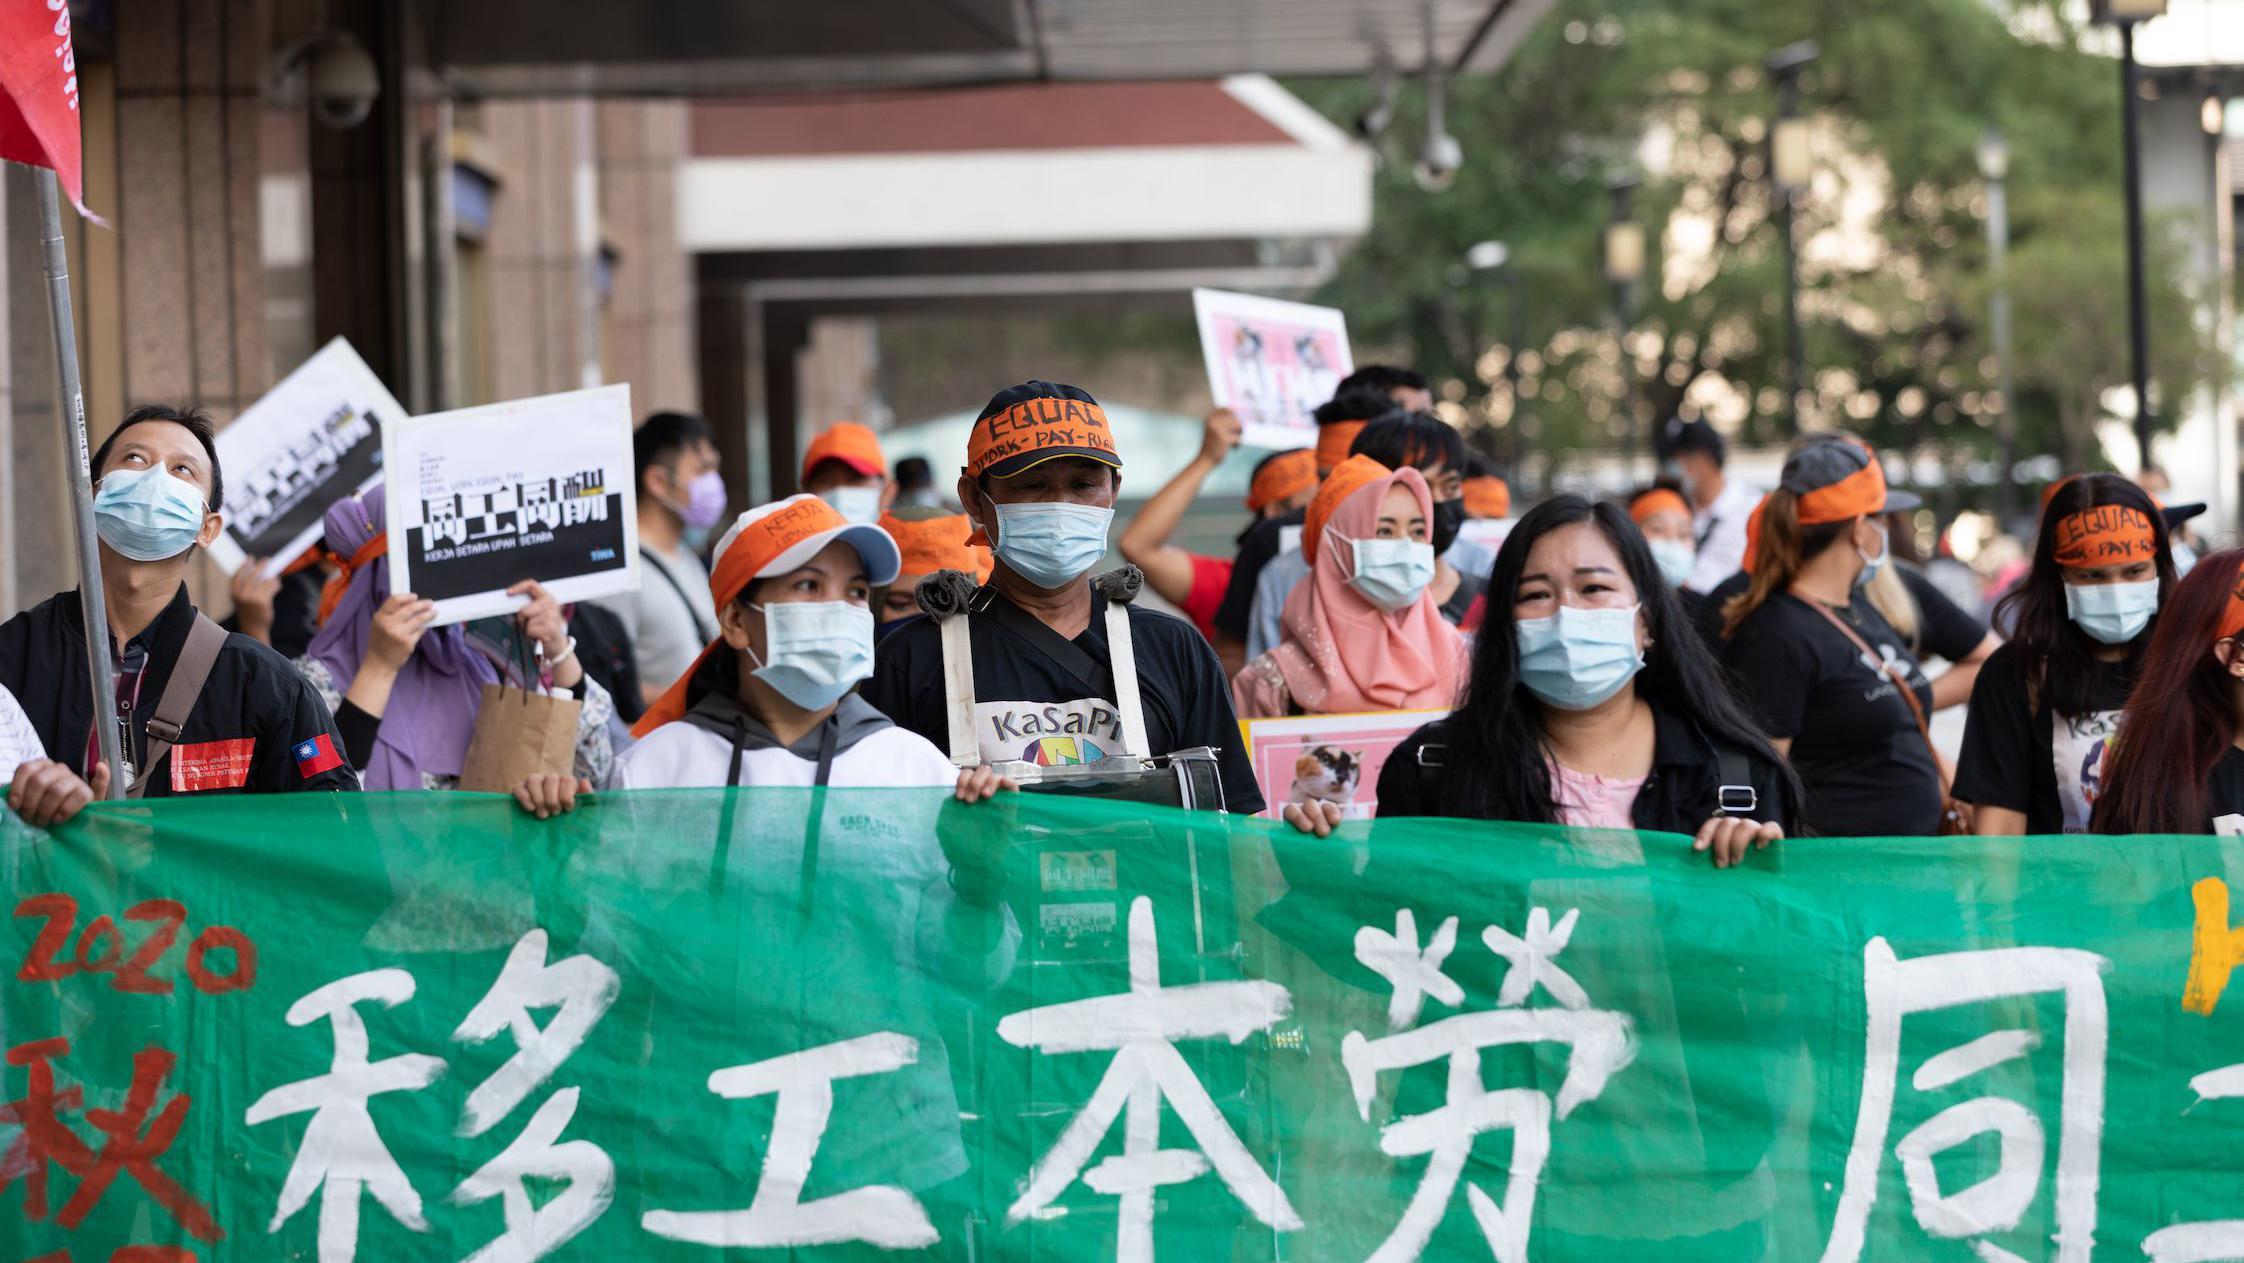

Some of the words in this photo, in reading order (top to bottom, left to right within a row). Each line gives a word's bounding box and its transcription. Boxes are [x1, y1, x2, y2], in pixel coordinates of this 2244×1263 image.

[988, 400, 1103, 442] EQUAL
[2066, 507, 2148, 541] EQUAL
[12, 892, 258, 995] 2020
